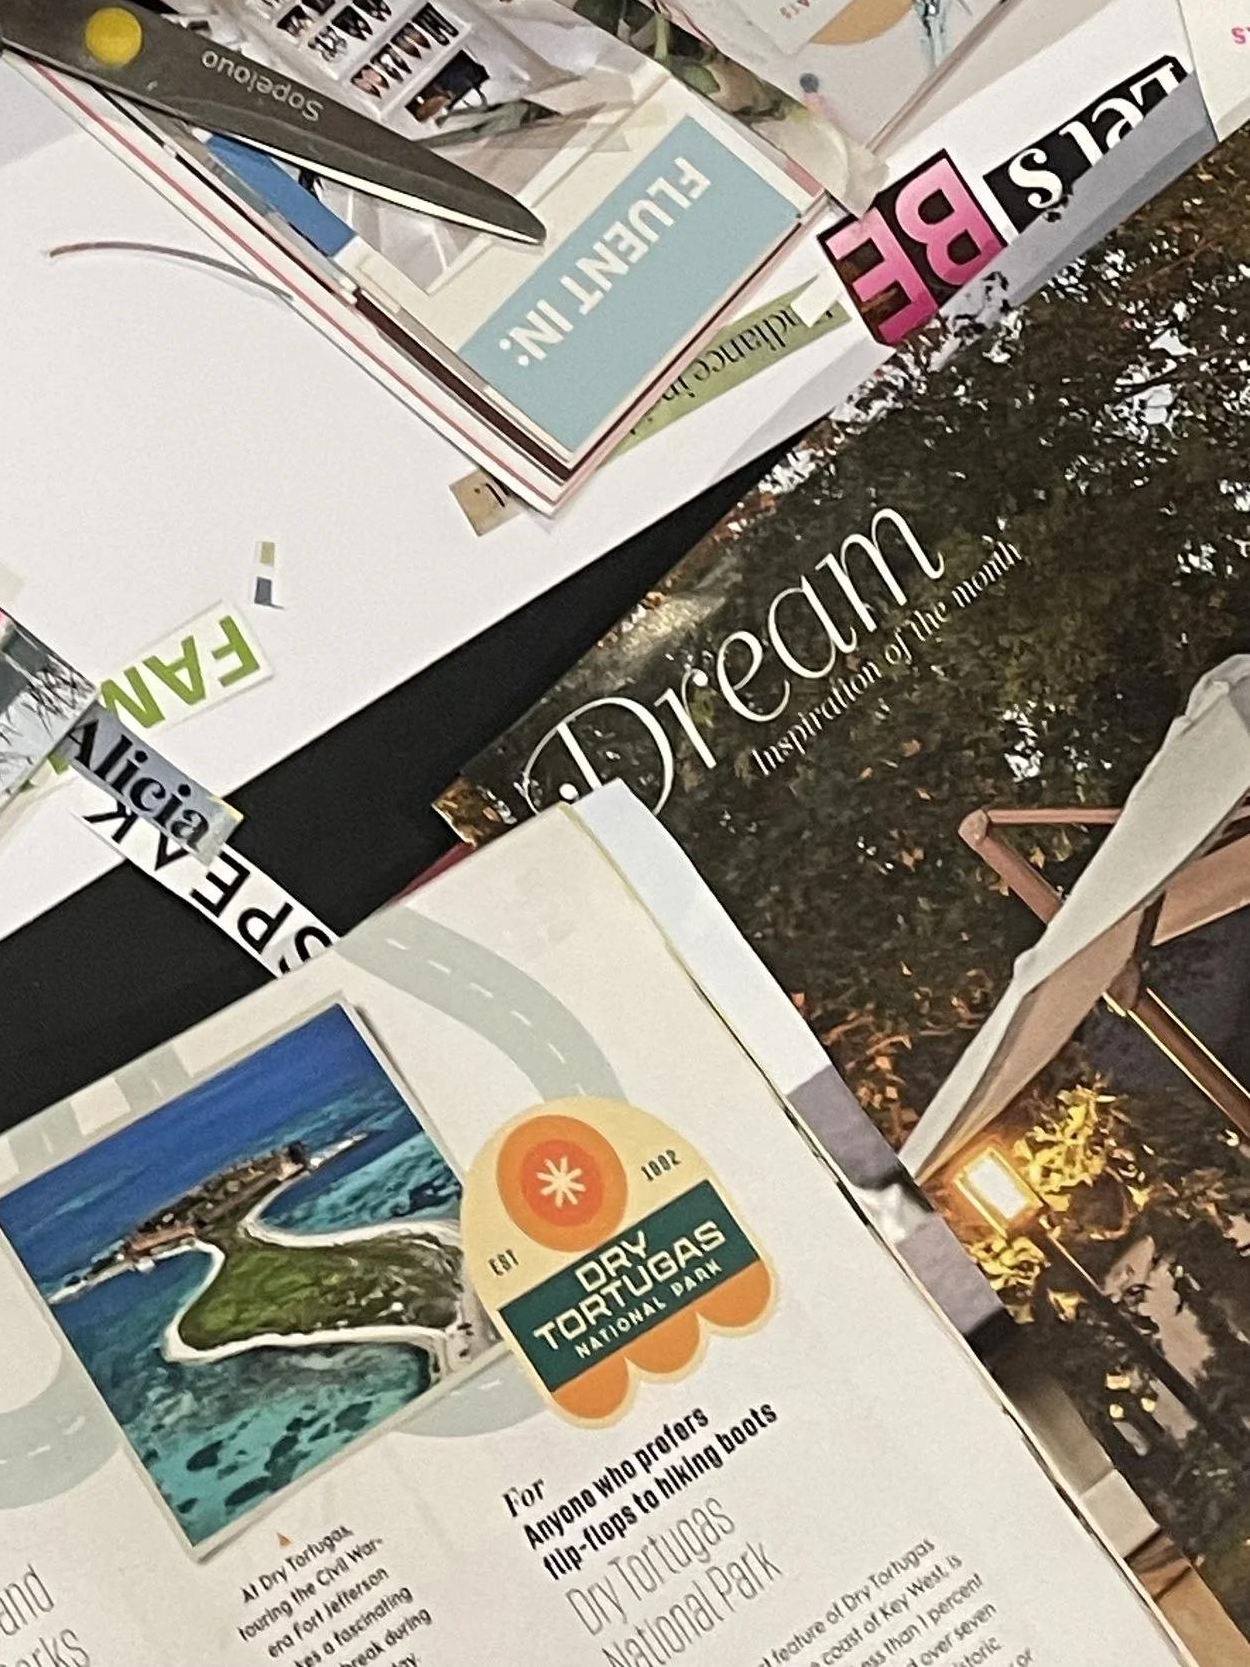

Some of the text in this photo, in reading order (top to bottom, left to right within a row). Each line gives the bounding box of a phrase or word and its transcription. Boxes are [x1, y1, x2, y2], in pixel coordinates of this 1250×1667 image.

[1006, 63, 1190, 213] Lets
[500, 157, 710, 366] FLUENT IN:
[827, 176, 1000, 344] BE
[688, 309, 834, 389] adiance
[100, 616, 261, 731] FAM
[524, 506, 944, 816] Dream
[749, 537, 1024, 777] Inspiration of the month
[64, 719, 208, 851] Alicia
[87, 808, 335, 974] SPEAK
[489, 1250, 518, 1275] EST
[534, 1221, 725, 1349] TORTUGAS
[575, 1230, 646, 1292] DRY
[575, 1259, 722, 1358] NATIONAL PARK
[504, 1480, 543, 1517] For
[524, 1409, 708, 1550] Anyone who prefers
[544, 1405, 776, 1580] flip-flops to hiking boots
[238, 1601, 292, 1641] touring
[290, 1583, 315, 1604] the
[317, 1557, 349, 1586] Civil
[243, 1584, 258, 1602] At
[259, 1568, 287, 1590] Dry
[269, 1569, 388, 1657] era Fort Jefferson
[566, 1498, 734, 1635] Dry Tortugas
[602, 1542, 782, 1667] National Park
[827, 1602, 844, 1624] of
[841, 1586, 870, 1611] Dry
[868, 1540, 934, 1588] Tortugas
[864, 1612, 880, 1633] of
[879, 1594, 909, 1620] Key
[884, 1625, 920, 1654] than
[927, 1573, 982, 1625] percent
[323, 1642, 335, 1654] a
[334, 1588, 412, 1646] fascinating
[385, 1609, 431, 1646] during
[921, 1604, 996, 1666] over seven
